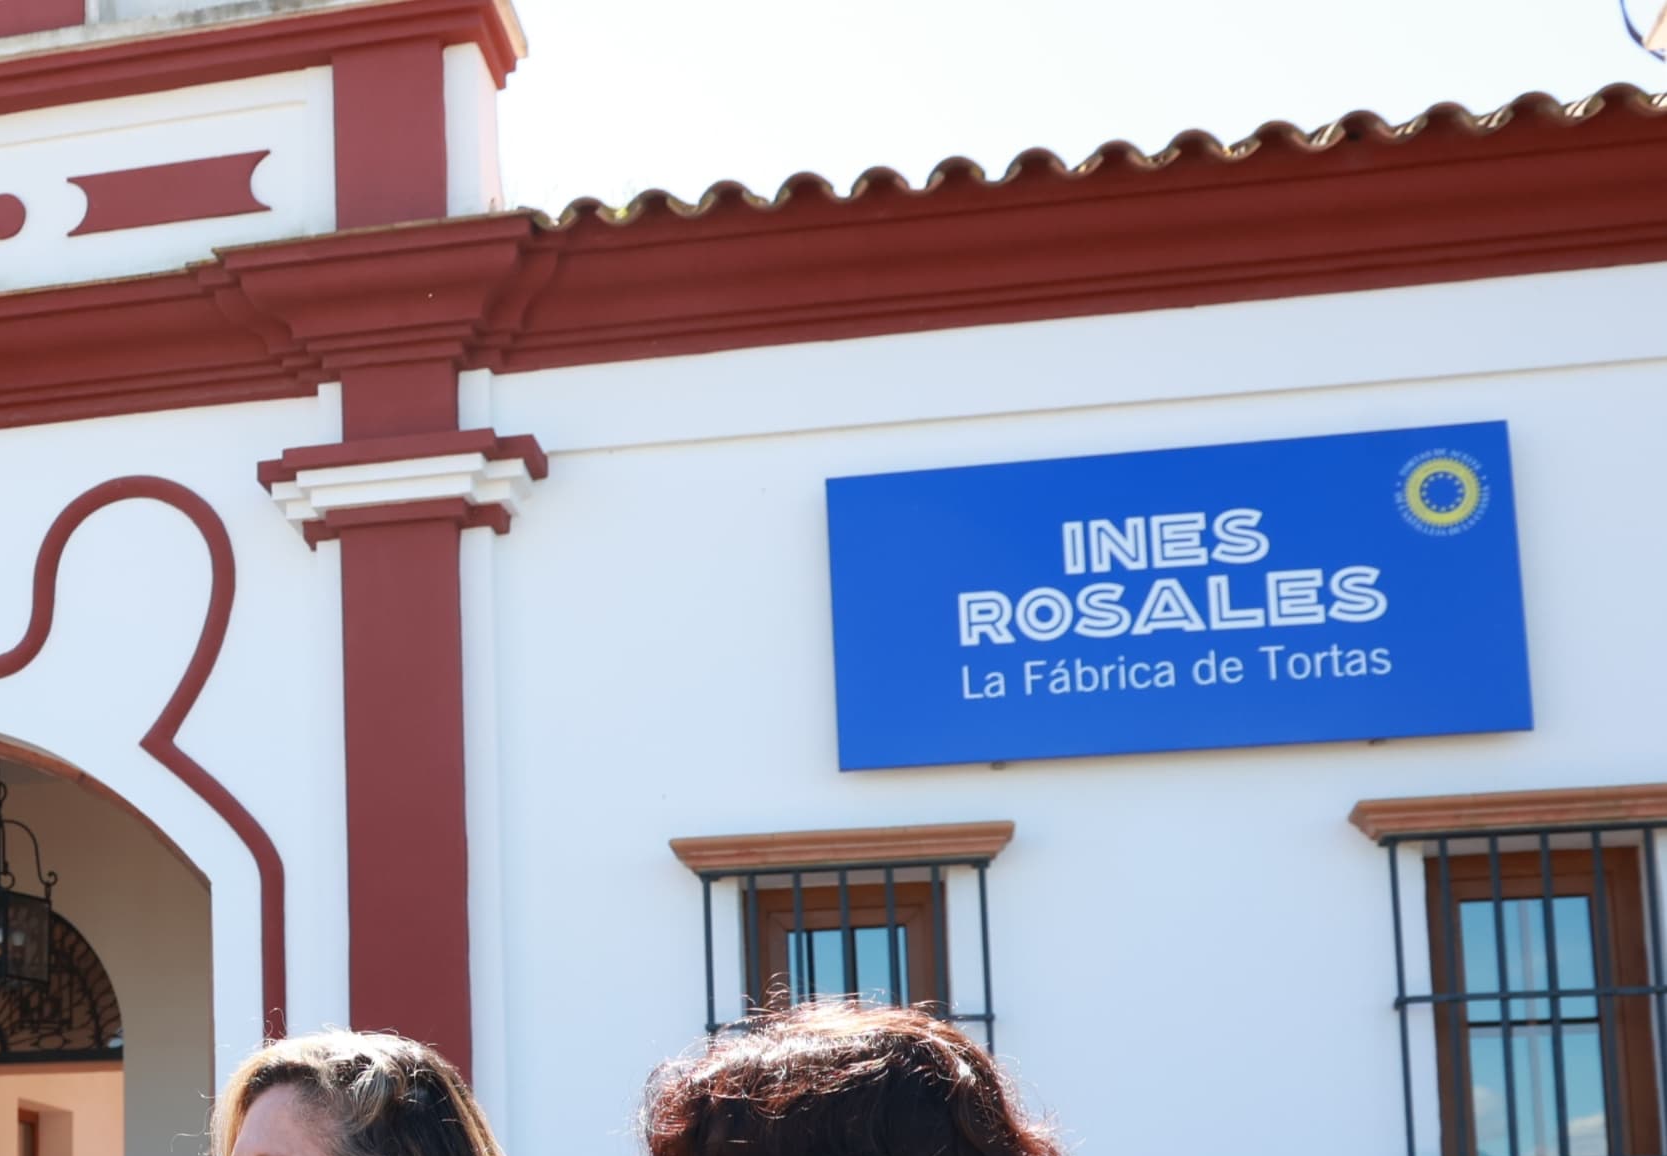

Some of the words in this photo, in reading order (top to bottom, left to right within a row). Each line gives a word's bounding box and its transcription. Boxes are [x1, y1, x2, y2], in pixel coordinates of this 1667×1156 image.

[1061, 508, 1270, 575] INES
[957, 565, 1388, 647] ROSALES
[961, 665, 1006, 699] La
[1024, 656, 1176, 695] Fábrica
[1192, 650, 1244, 685] de
[1259, 644, 1392, 681] Tortas
